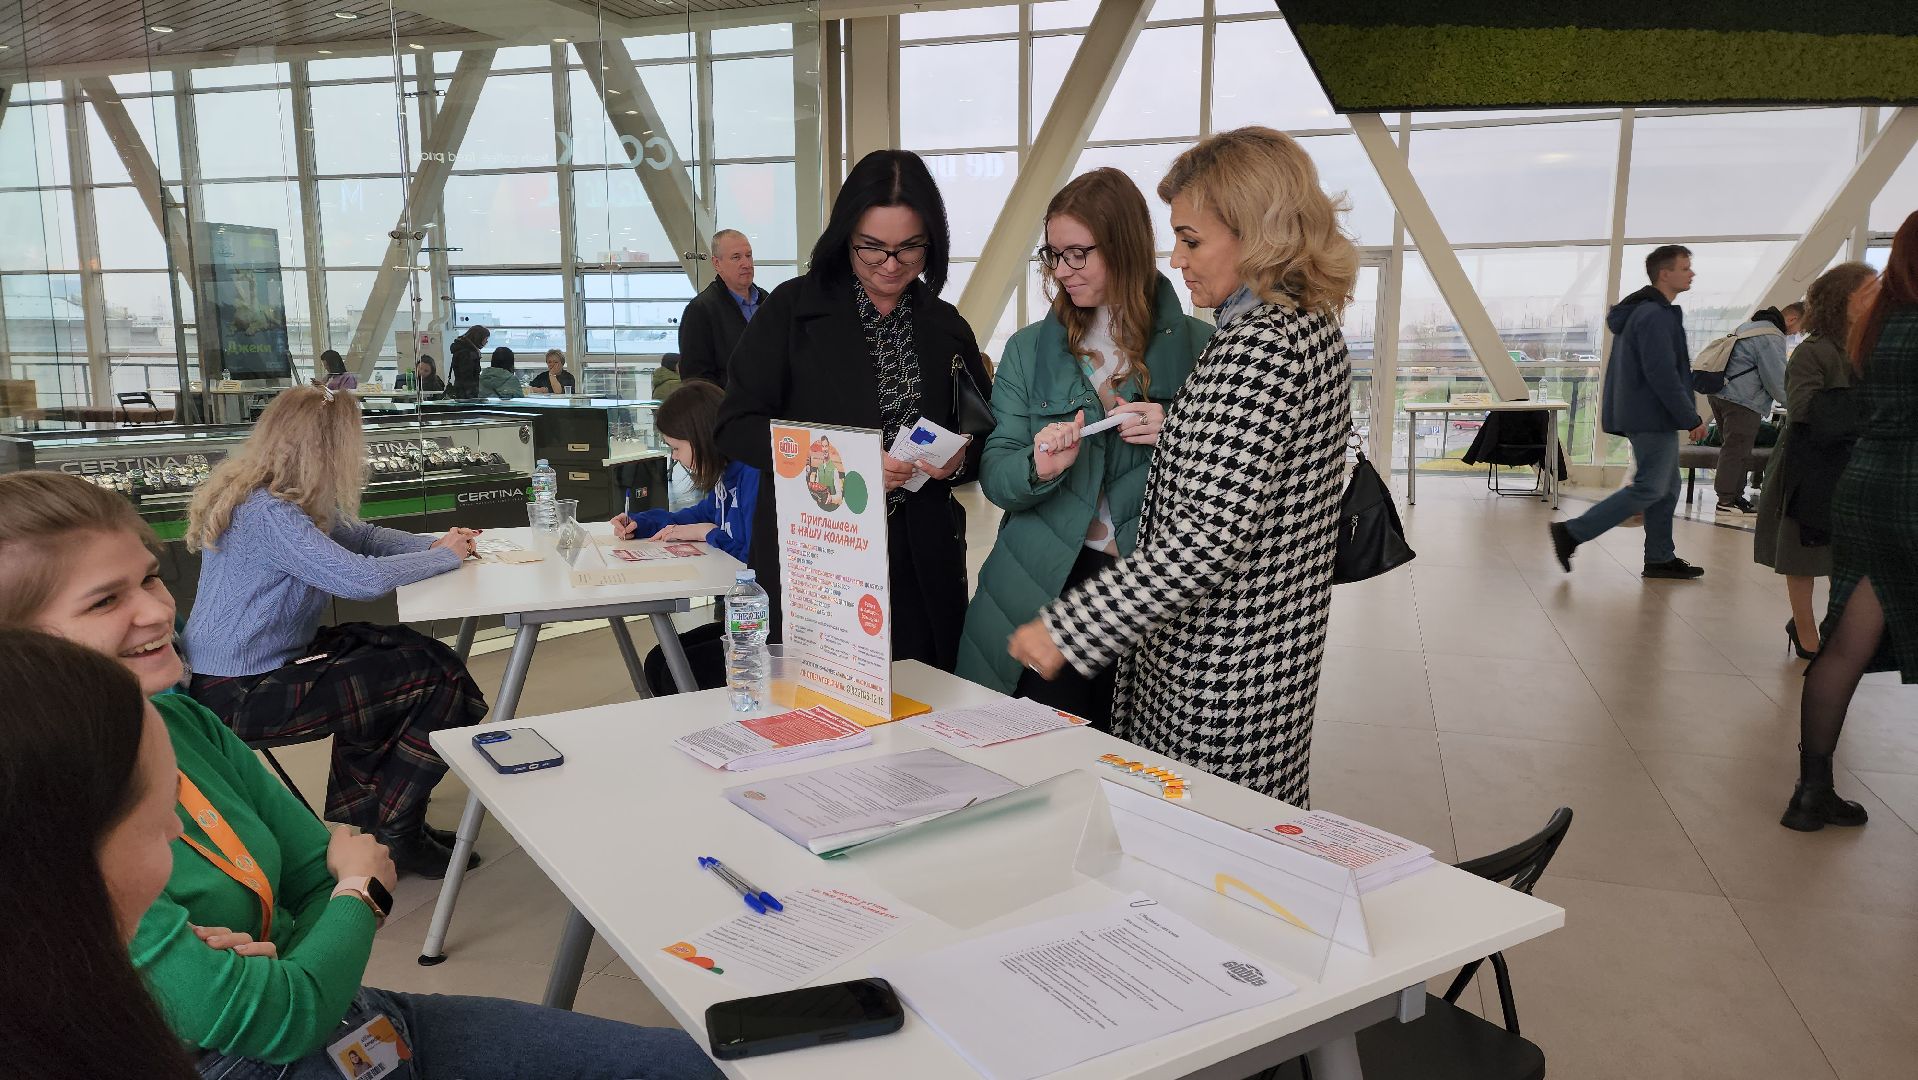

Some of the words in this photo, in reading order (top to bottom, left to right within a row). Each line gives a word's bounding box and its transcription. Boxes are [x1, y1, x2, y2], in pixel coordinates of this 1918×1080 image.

[60, 456, 182, 475] CERTINA
[457, 487, 524, 503] CERTINA
[800, 512, 858, 534] Приглашаем
